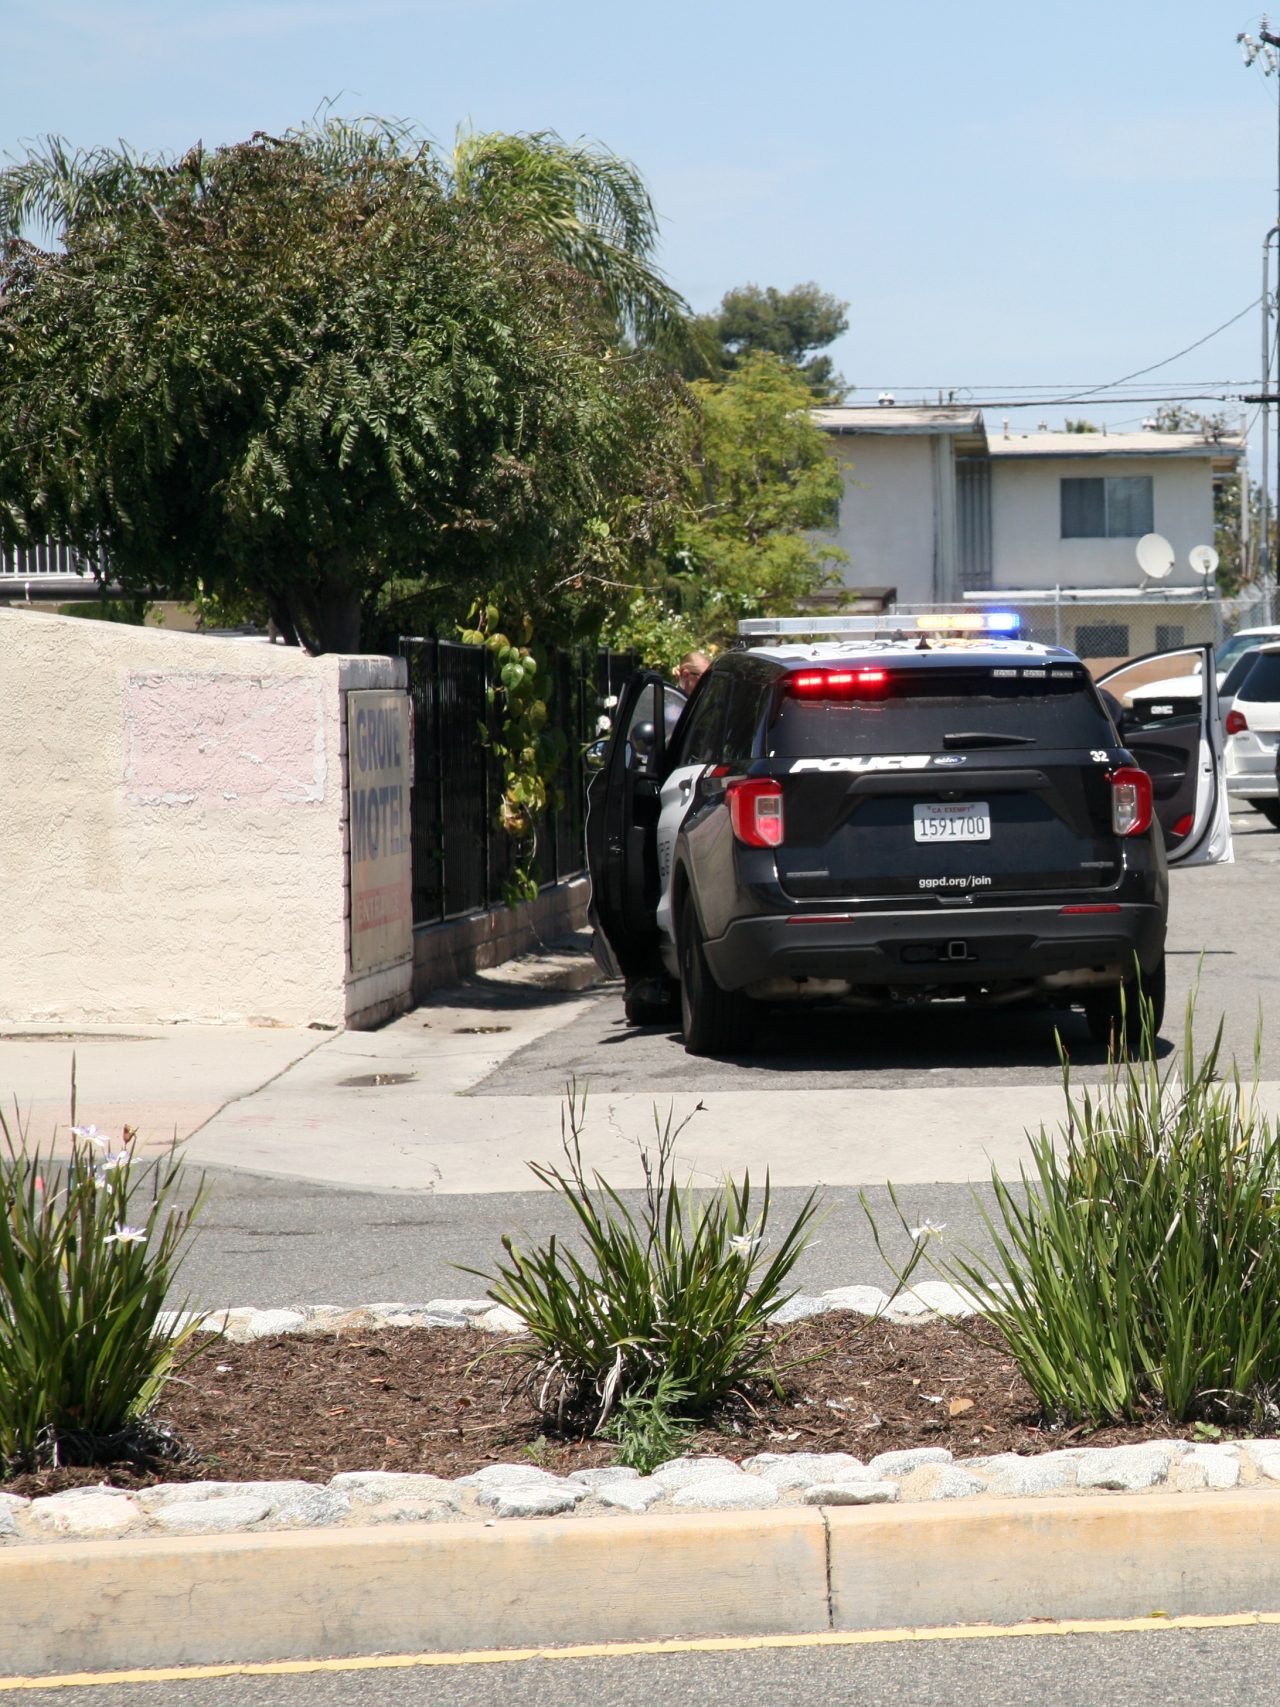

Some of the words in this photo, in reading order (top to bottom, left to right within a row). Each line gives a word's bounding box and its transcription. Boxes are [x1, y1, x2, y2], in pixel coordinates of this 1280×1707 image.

[356, 707, 401, 772] GROVE
[789, 755, 931, 773] POLICE
[1089, 750, 1110, 762] 32
[944, 806, 971, 814] EXEMPT
[352, 784, 408, 863] MOTEL
[920, 816, 985, 837] 1591700
[918, 875, 992, 889] ggpd.org/join
